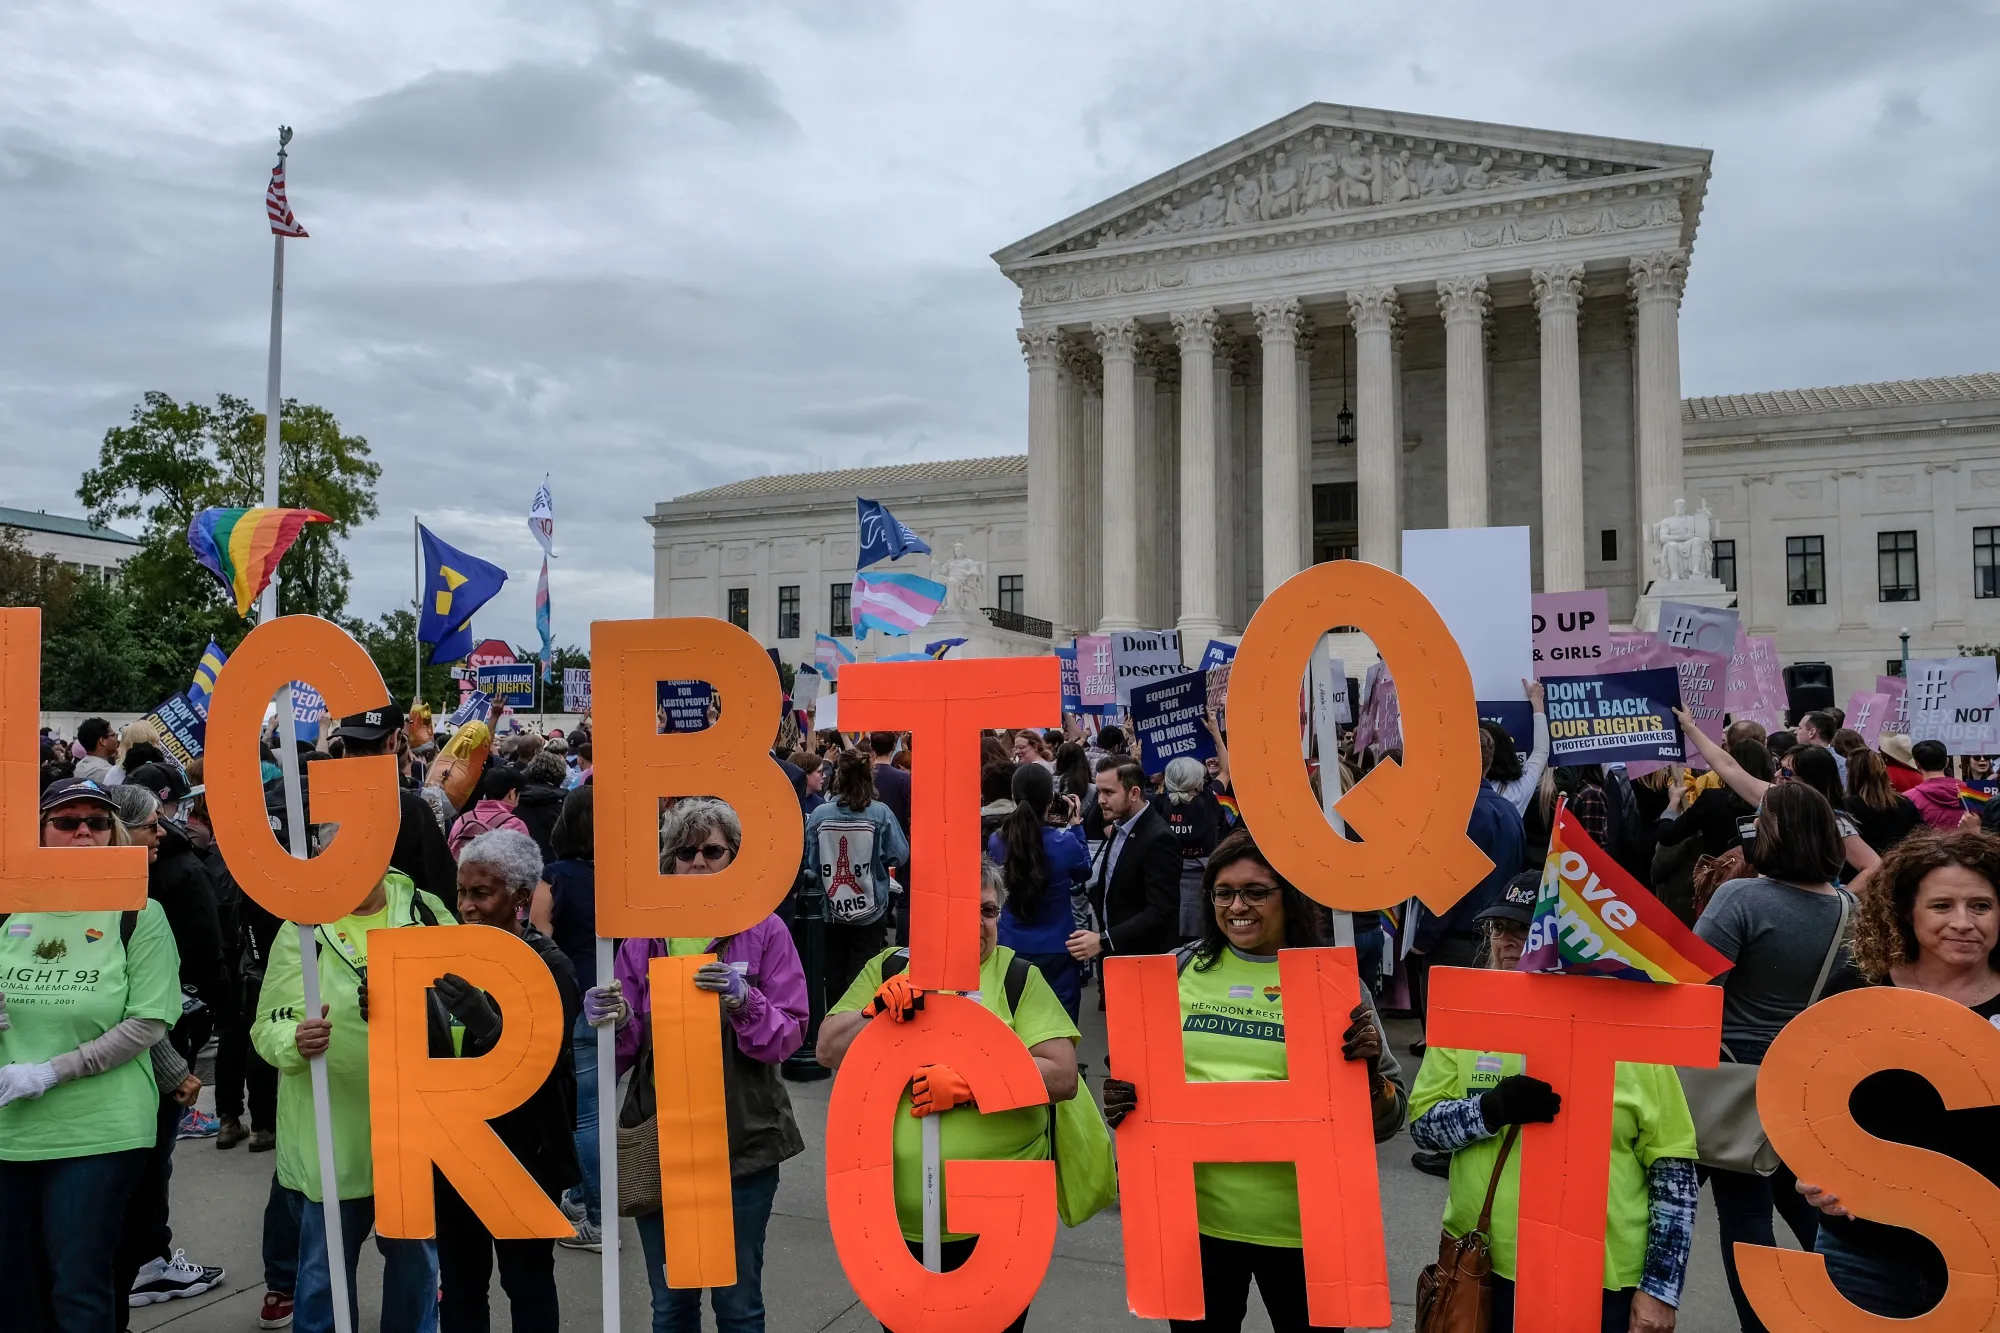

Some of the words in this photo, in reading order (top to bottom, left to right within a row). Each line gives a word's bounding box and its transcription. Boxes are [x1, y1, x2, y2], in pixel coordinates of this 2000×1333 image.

[1203, 259, 1260, 279] EQUAL
[1265, 252, 1334, 271] JUSTICE
[1345, 240, 1404, 261] UNDER
[1413, 235, 1448, 251] LAW
[1557, 610, 1596, 633] UP
[1122, 635, 1169, 651] Don't
[1550, 645, 1602, 661] GIRLS
[1676, 661, 1710, 678] ON'T
[480, 675, 496, 684] DON'T
[497, 674, 532, 683] ROLLBACK
[497, 682, 532, 694] RIGHTS
[678, 687, 692, 696] FOR
[1145, 682, 1192, 703] EQUALITY
[1547, 681, 1604, 701] DON'T
[663, 698, 684, 707] LGBTQ
[685, 697, 710, 707] PEOPLE
[1160, 698, 1179, 712] FOR
[1333, 691, 1346, 703] OT
[169, 697, 199, 728] DON'T
[671, 709, 681, 718] NO
[1548, 701, 1595, 720] ROLL
[1598, 697, 1651, 719] BACK
[675, 720, 685, 728] NO
[686, 719, 702, 728] LESS
[1136, 714, 1170, 732] LGBTQ
[1169, 703, 1205, 723] PEOPLE
[157, 705, 182, 731] ROLL
[175, 727, 203, 757] BACK
[1150, 729, 1165, 744] NO
[1166, 722, 1197, 740] MORE,
[1550, 719, 1590, 739] OUR
[1593, 716, 1664, 737] RIGHTS
[1913, 724, 1989, 741] GENDER
[147, 713, 168, 734] OUR
[160, 732, 194, 769] RIGHTS
[1157, 745, 1172, 759] NO
[1172, 738, 1197, 752] LESS
[1555, 738, 1596, 751] PROTECT
[1597, 735, 1627, 748] LGBTQ
[1628, 732, 1674, 744] WORKERS
[1658, 746, 1681, 756] ACLU
[1171, 813, 1182, 822] NO
[1505, 884, 1536, 901] Love
[1560, 851, 1637, 930] ove
[0, 966, 70, 983] IGHT
[74, 969, 100, 984] 93
[34, 984, 97, 992] MEMORIAL
[1191, 1001, 1244, 1016] HERNDON
[1187, 1018, 1285, 1039] INDIVISIBL
